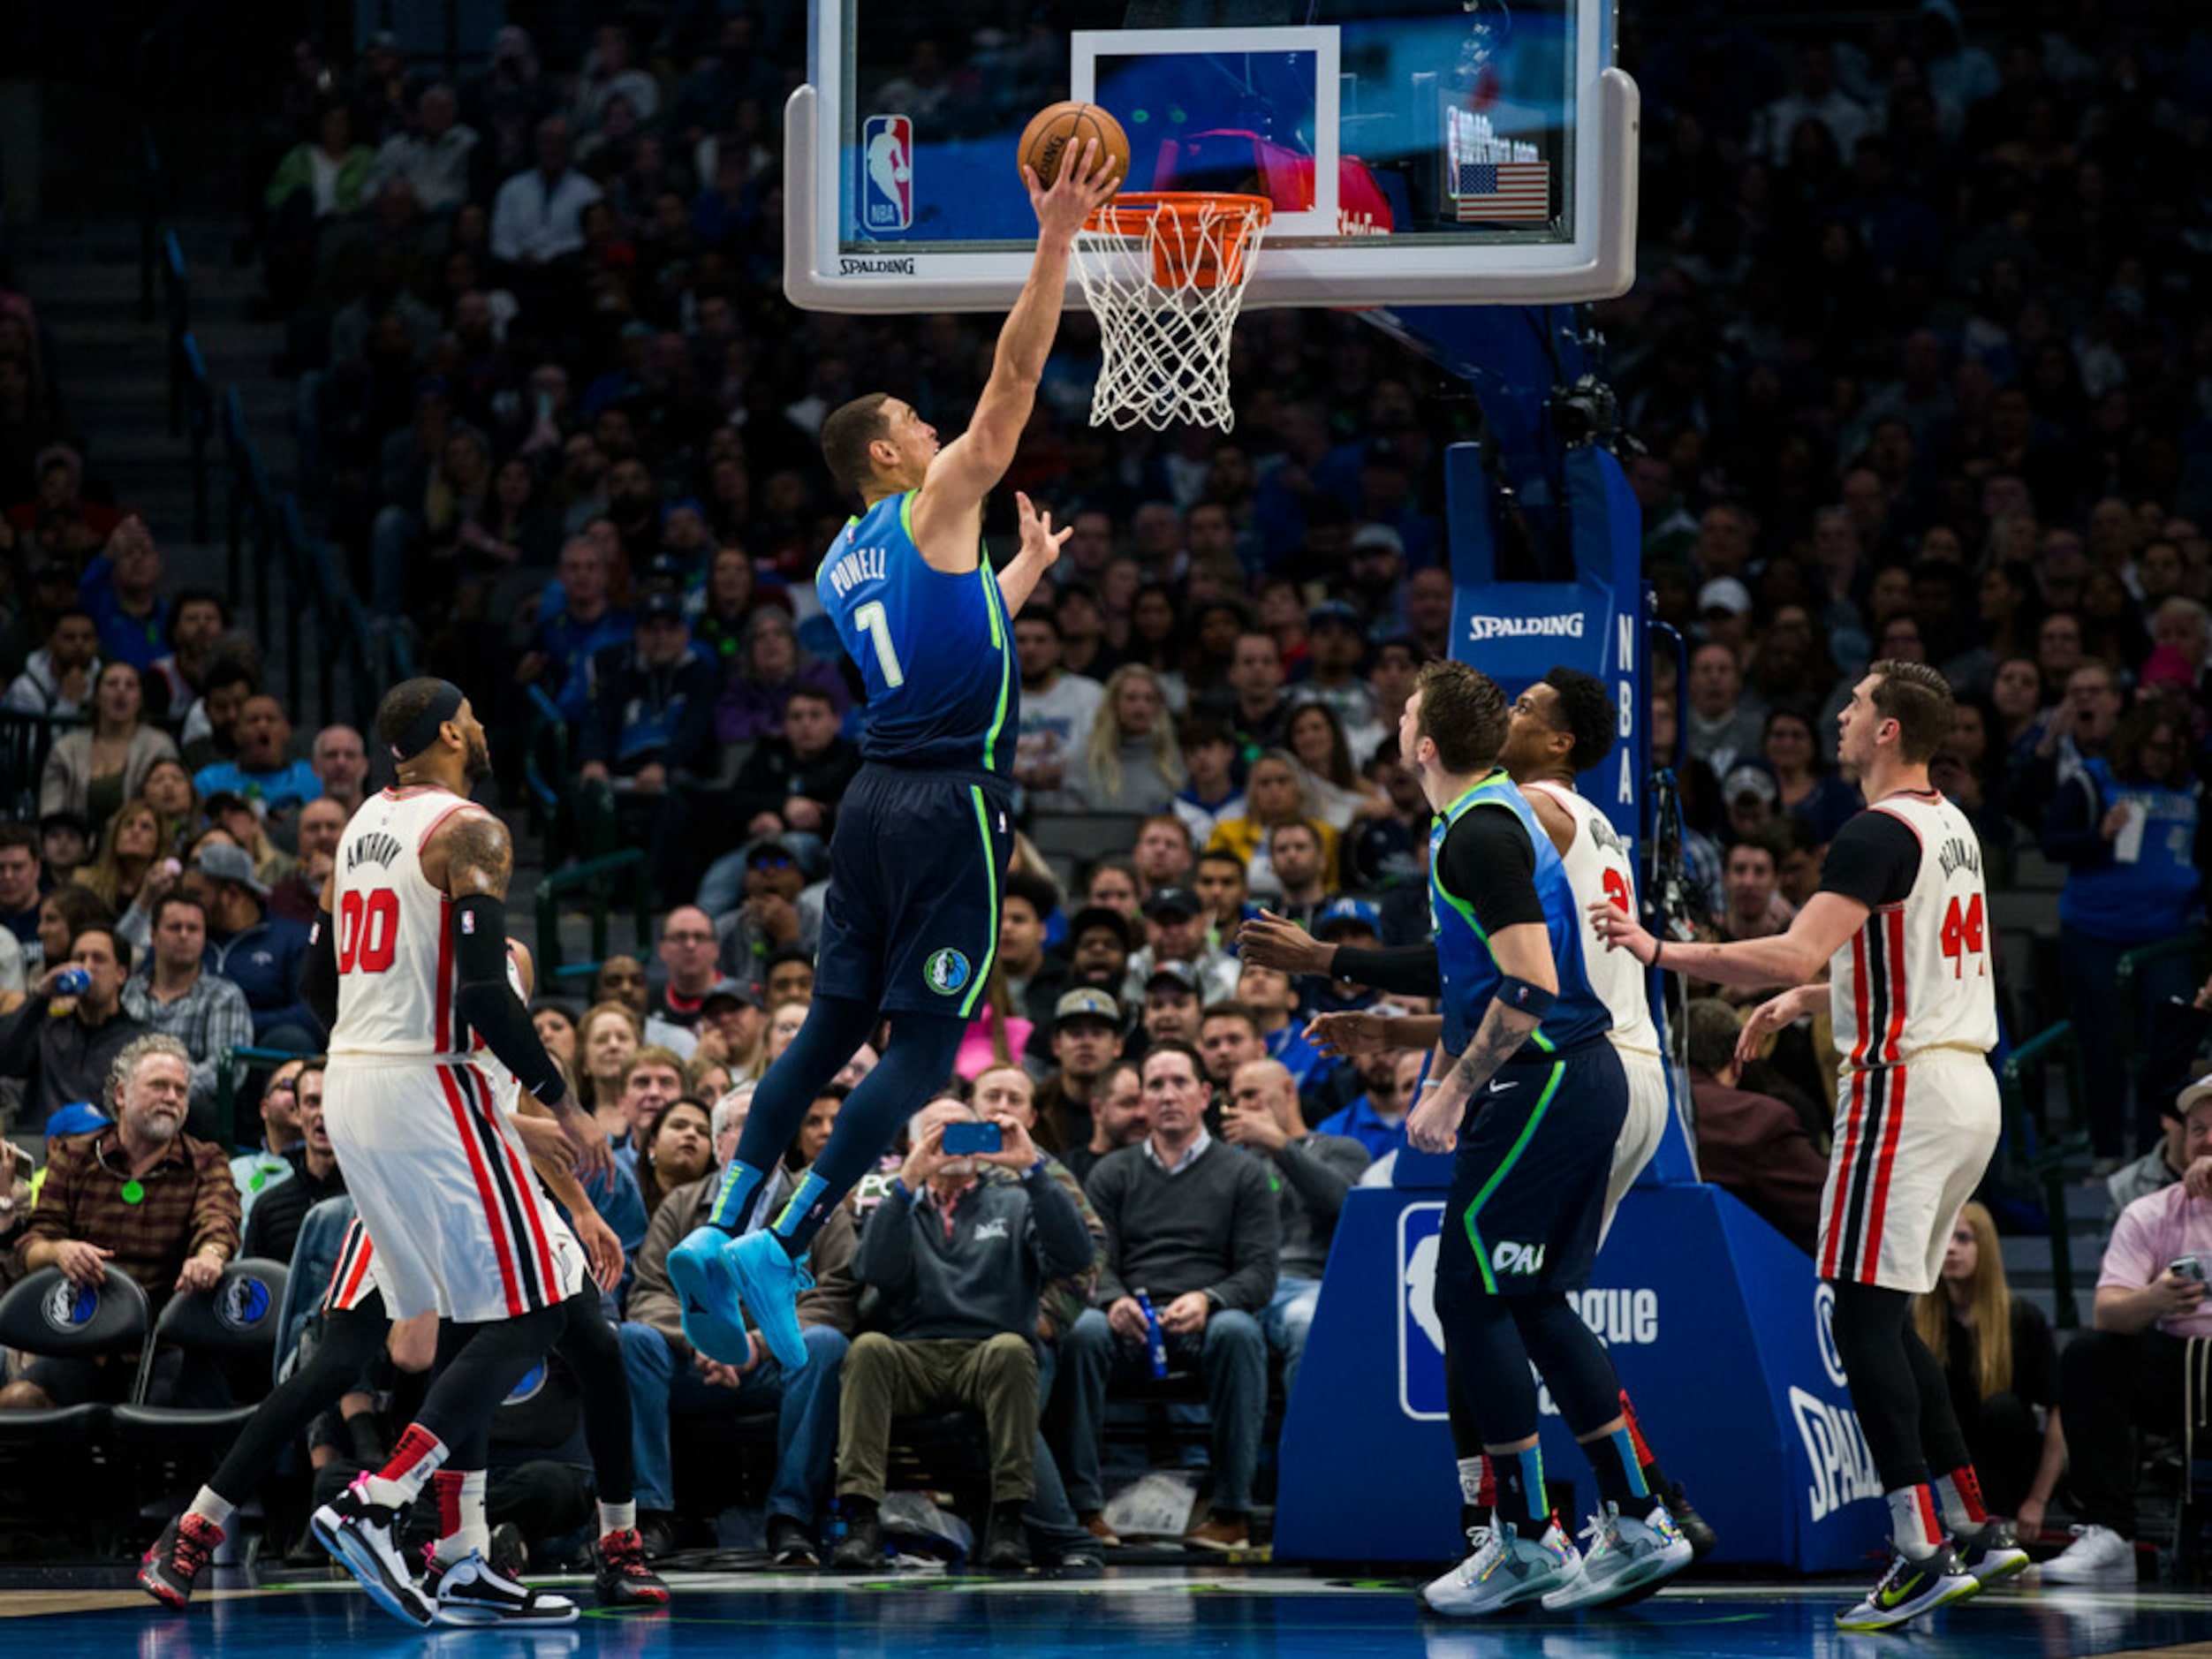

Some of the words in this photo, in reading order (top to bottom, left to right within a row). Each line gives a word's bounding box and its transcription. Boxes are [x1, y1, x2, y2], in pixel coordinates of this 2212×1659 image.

[870, 204, 896, 223] NBA
[839, 257, 915, 276] SPALDING
[830, 547, 886, 598] POWELL
[853, 600, 905, 688] 7
[1468, 612, 1585, 640] SPALDING
[347, 831, 402, 875] ANTHONY
[338, 888, 400, 974] 00
[1940, 893, 1984, 980] 44
[1566, 1288, 1659, 1349] gue
